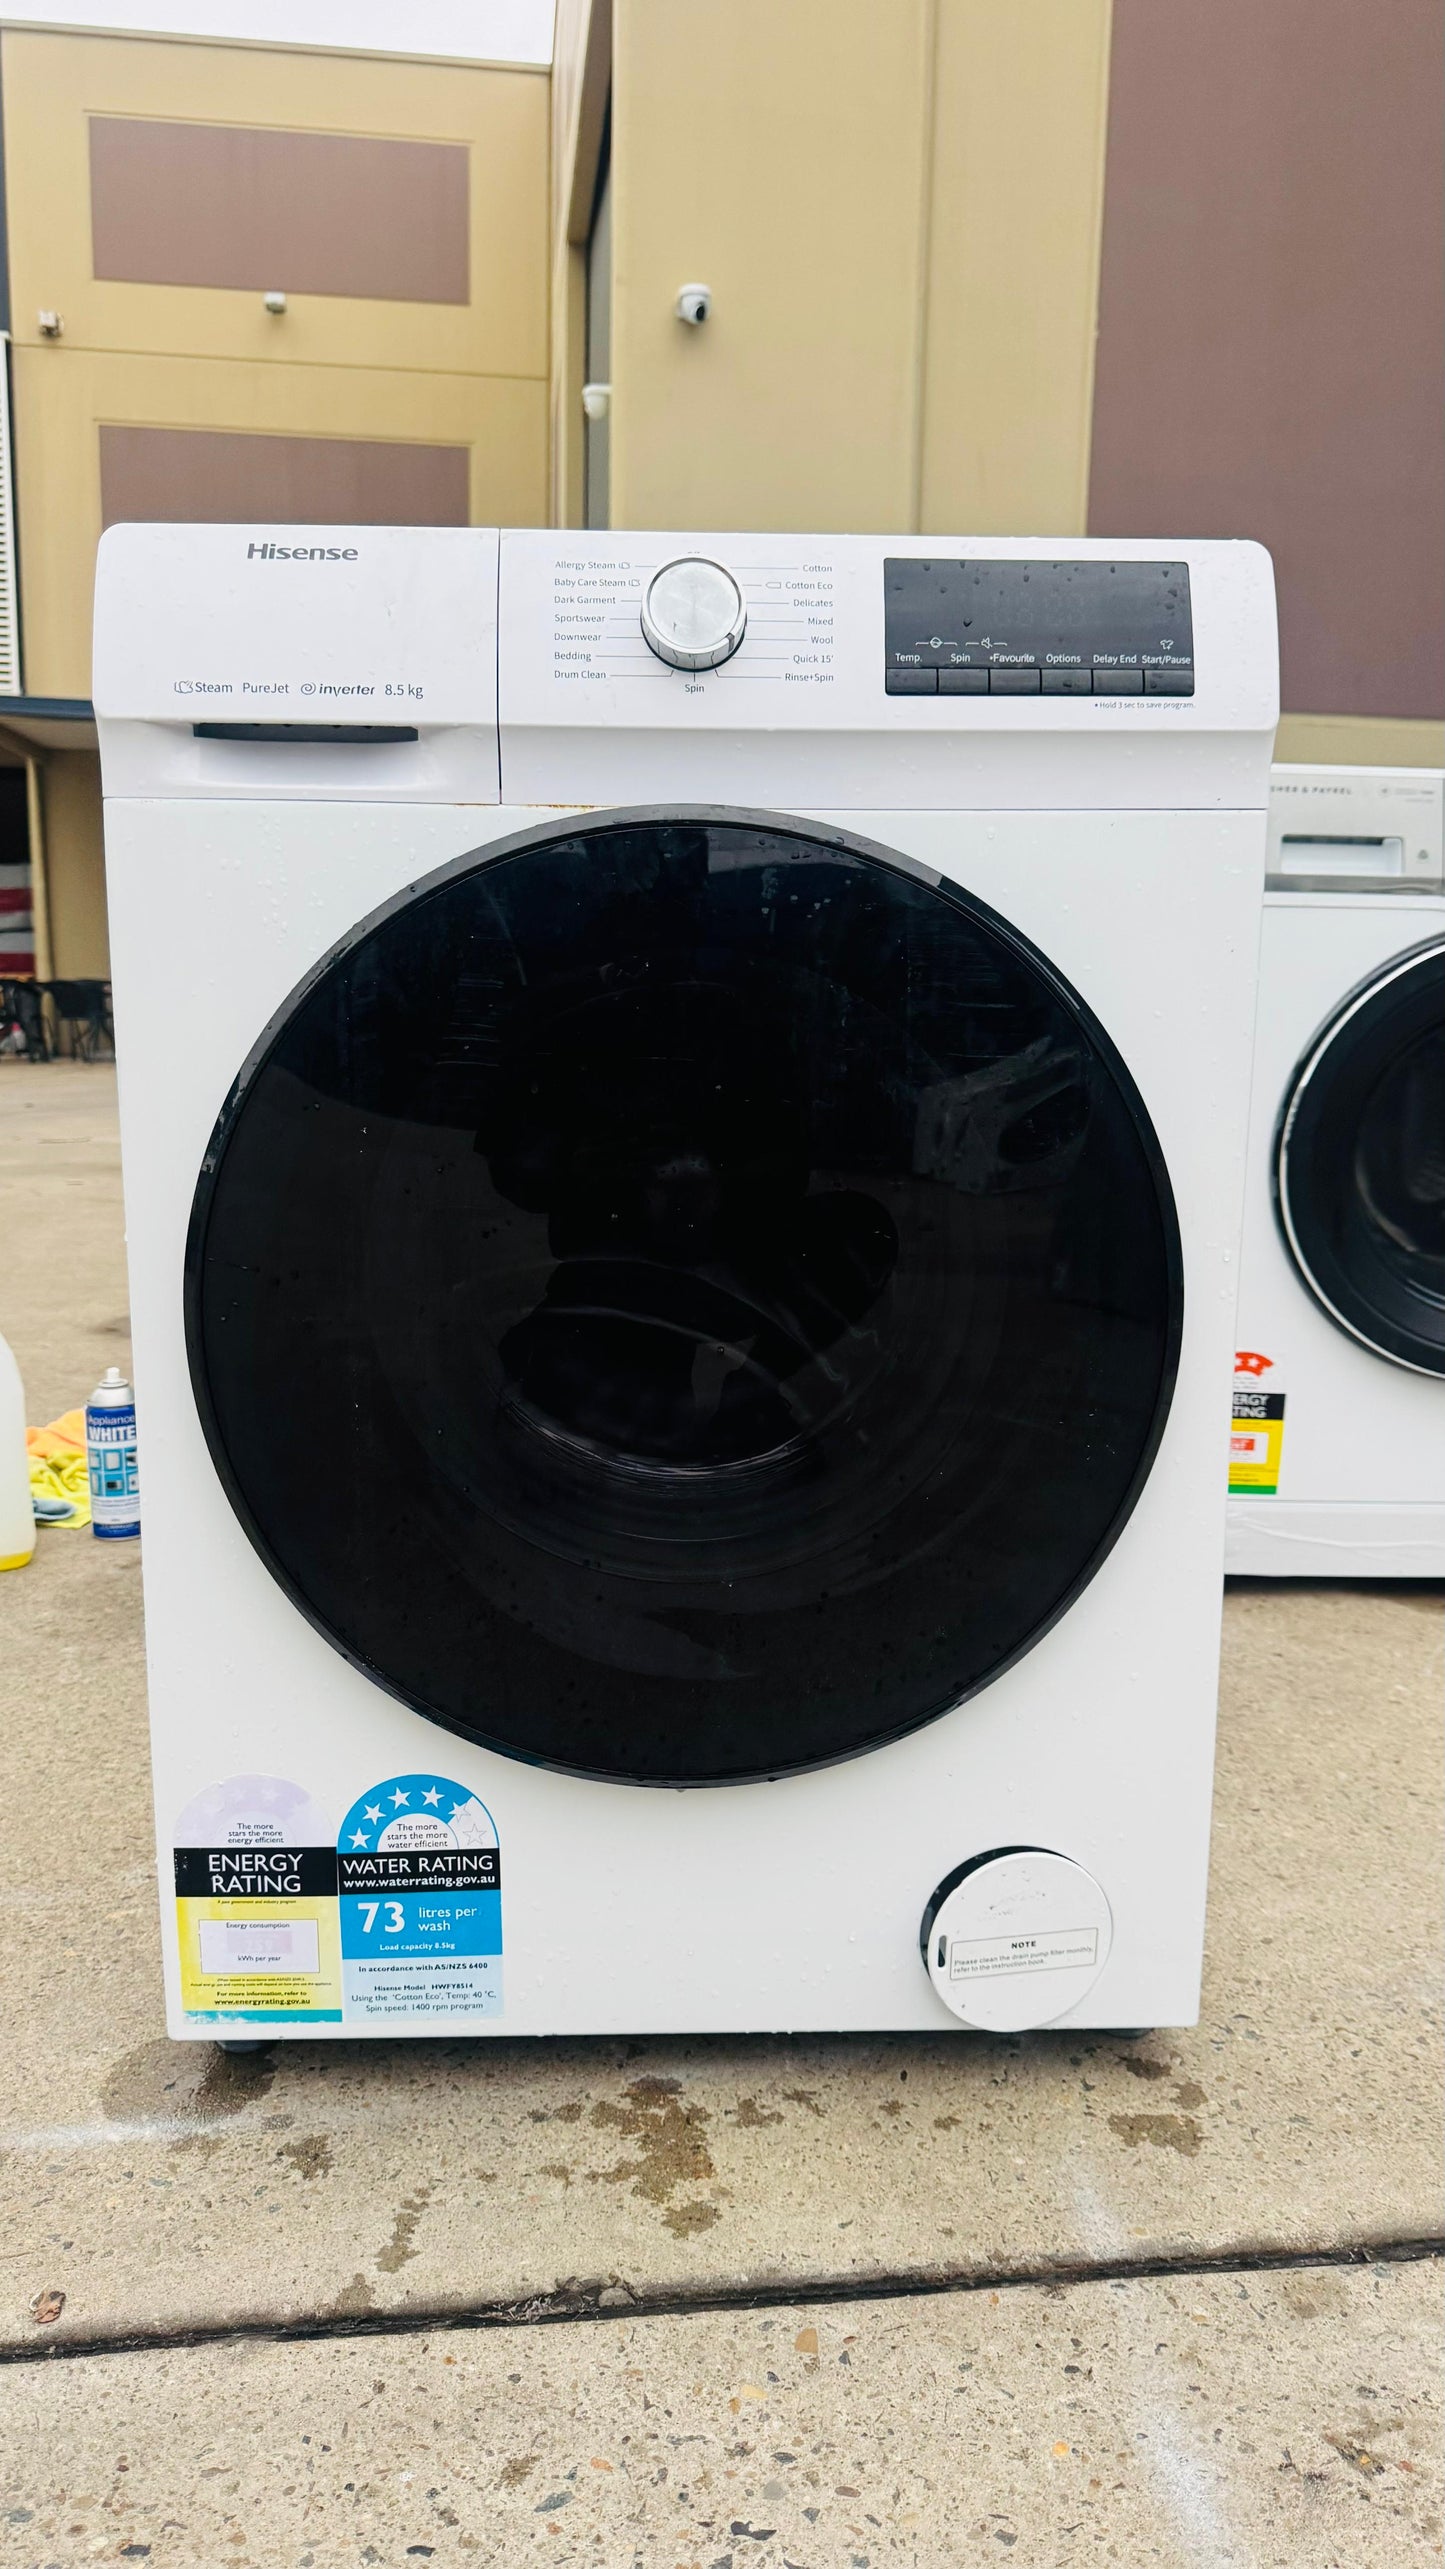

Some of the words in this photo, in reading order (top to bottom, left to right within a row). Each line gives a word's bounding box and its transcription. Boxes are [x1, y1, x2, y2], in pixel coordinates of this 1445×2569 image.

[247, 543, 358, 561] Hisense
[554, 560, 586, 570] Allergy
[588, 561, 616, 570] Steam
[802, 564, 832, 573] Cotton
[554, 578, 576, 588] Baby
[578, 578, 598, 587] Care
[600, 578, 626, 587] Steam
[785, 581, 814, 590] Cotton
[817, 582, 833, 590] Eco
[554, 596, 574, 604] Dark
[577, 596, 616, 604] Garment
[793, 599, 833, 608] Delicates
[554, 614, 606, 624] Sportswear
[807, 617, 834, 626] Mixed
[554, 632, 602, 641] Downwear
[810, 636, 834, 644] Wool
[554, 651, 592, 662] Bedding
[792, 654, 818, 664] Quick
[820, 654, 834, 663] 15'
[895, 653, 922, 664] Temp.
[950, 653, 970, 664] Spin
[993, 653, 1035, 663] Favourite
[1046, 654, 1081, 664] Options
[1093, 654, 1118, 666] Delay
[1119, 654, 1137, 664] End
[1141, 654, 1191, 665] Start/Pause
[554, 670, 578, 679] Drum
[581, 670, 606, 679] Clean
[784, 672, 834, 683] Rinse+Spin
[195, 682, 233, 694] Steam
[242, 682, 290, 695] PureJet
[318, 684, 376, 698] inverter
[384, 684, 405, 696] 8.5
[407, 684, 424, 700] kg
[684, 684, 705, 694] Spin
[88, 1414, 135, 1426] Appliance
[88, 1425, 136, 1441] WHITE
[237, 1822, 252, 1830] The
[397, 1823, 413, 1831] The
[410, 1832, 424, 1840] the
[414, 1840, 448, 1848] efficient
[208, 1854, 303, 1872] ENERGY
[343, 1858, 412, 1874] WATER
[418, 1855, 494, 1872] RATING
[212, 1875, 301, 1893] RATING
[343, 1875, 496, 1888] www.waterrating.gov.au
[357, 1901, 406, 1934] 73
[418, 1906, 451, 1918] litres
[455, 1908, 478, 1920] per
[226, 1922, 248, 1930] Energy
[249, 1922, 290, 1930] consumption
[418, 1920, 451, 1932] wash
[401, 1943, 433, 1952] capacity
[434, 1942, 456, 1950] 8.5kg
[1011, 1941, 1037, 1949] NOTE
[954, 1958, 978, 1966] Please
[980, 1956, 998, 1964] clean
[1012, 1952, 1029, 1960] drain
[1030, 1952, 1048, 1960] pump
[434, 1963, 466, 1971] AS/NZS
[954, 1966, 970, 1974] refer
[992, 1960, 1027, 1970] instruction
[214, 1998, 311, 2006] www.energyrating.gov.au
[352, 1995, 374, 2003] Using
[446, 1992, 470, 2000] Temp:
[384, 2004, 409, 2012] speed:
[432, 2004, 448, 2012] rpm
[450, 2003, 484, 2012] program
